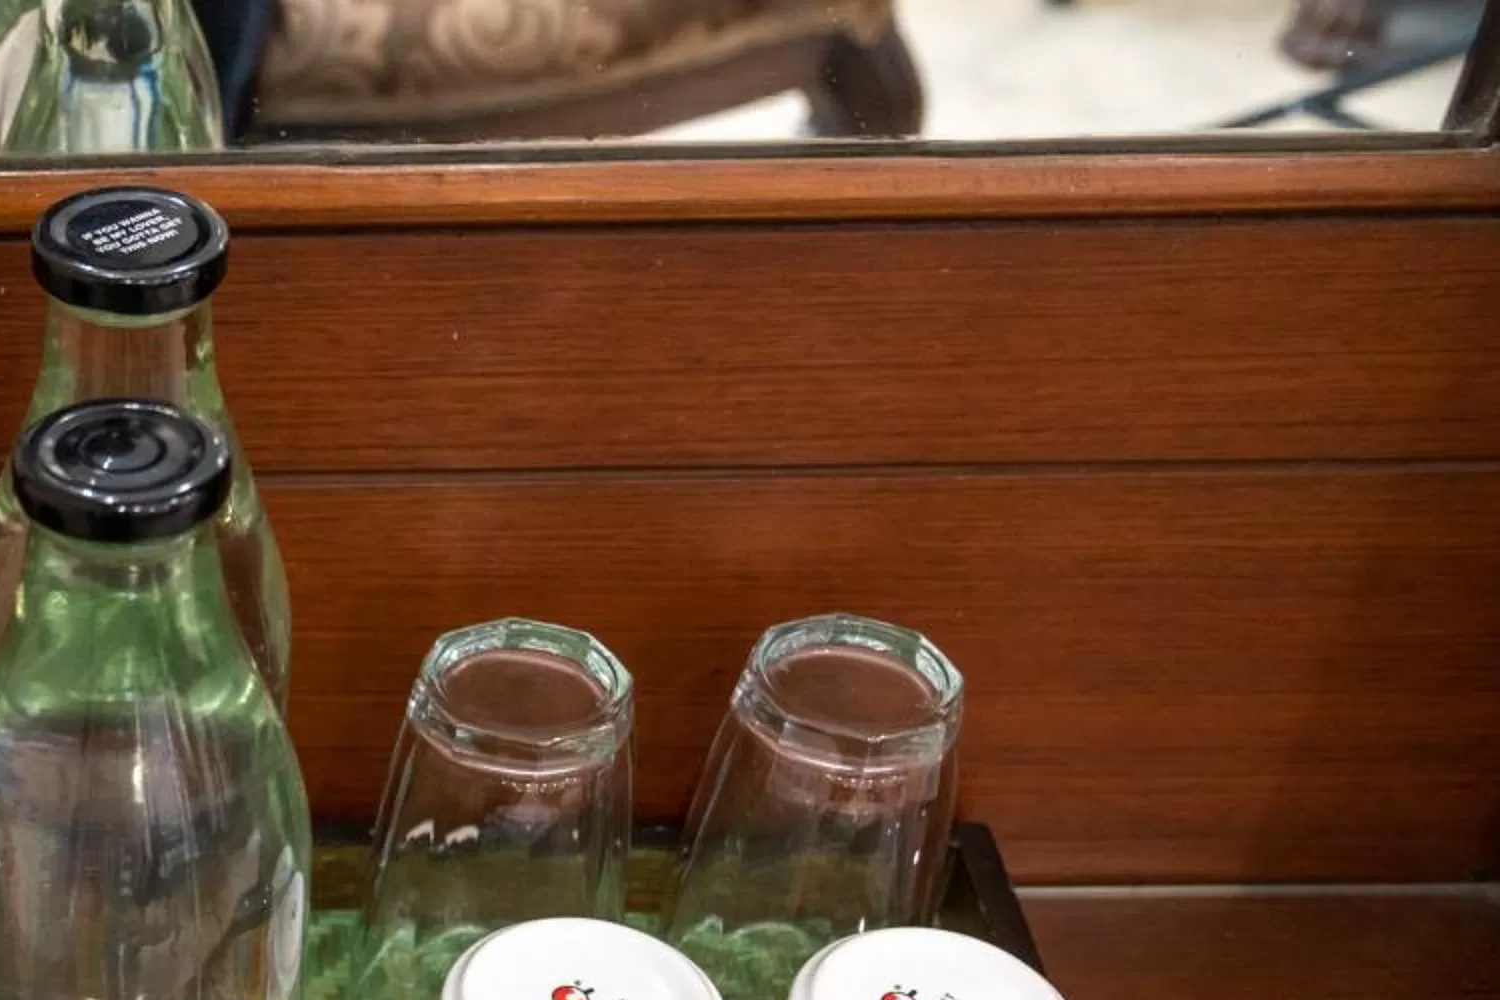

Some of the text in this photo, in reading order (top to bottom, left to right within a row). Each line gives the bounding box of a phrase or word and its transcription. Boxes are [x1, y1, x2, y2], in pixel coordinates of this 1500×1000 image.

[94, 224, 119, 235] YOU
[118, 208, 160, 226] WANNA
[92, 236, 110, 245] BE
[110, 229, 126, 239] MY
[95, 218, 182, 253] YOU GOTTA GET
[120, 241, 147, 254] THIS
